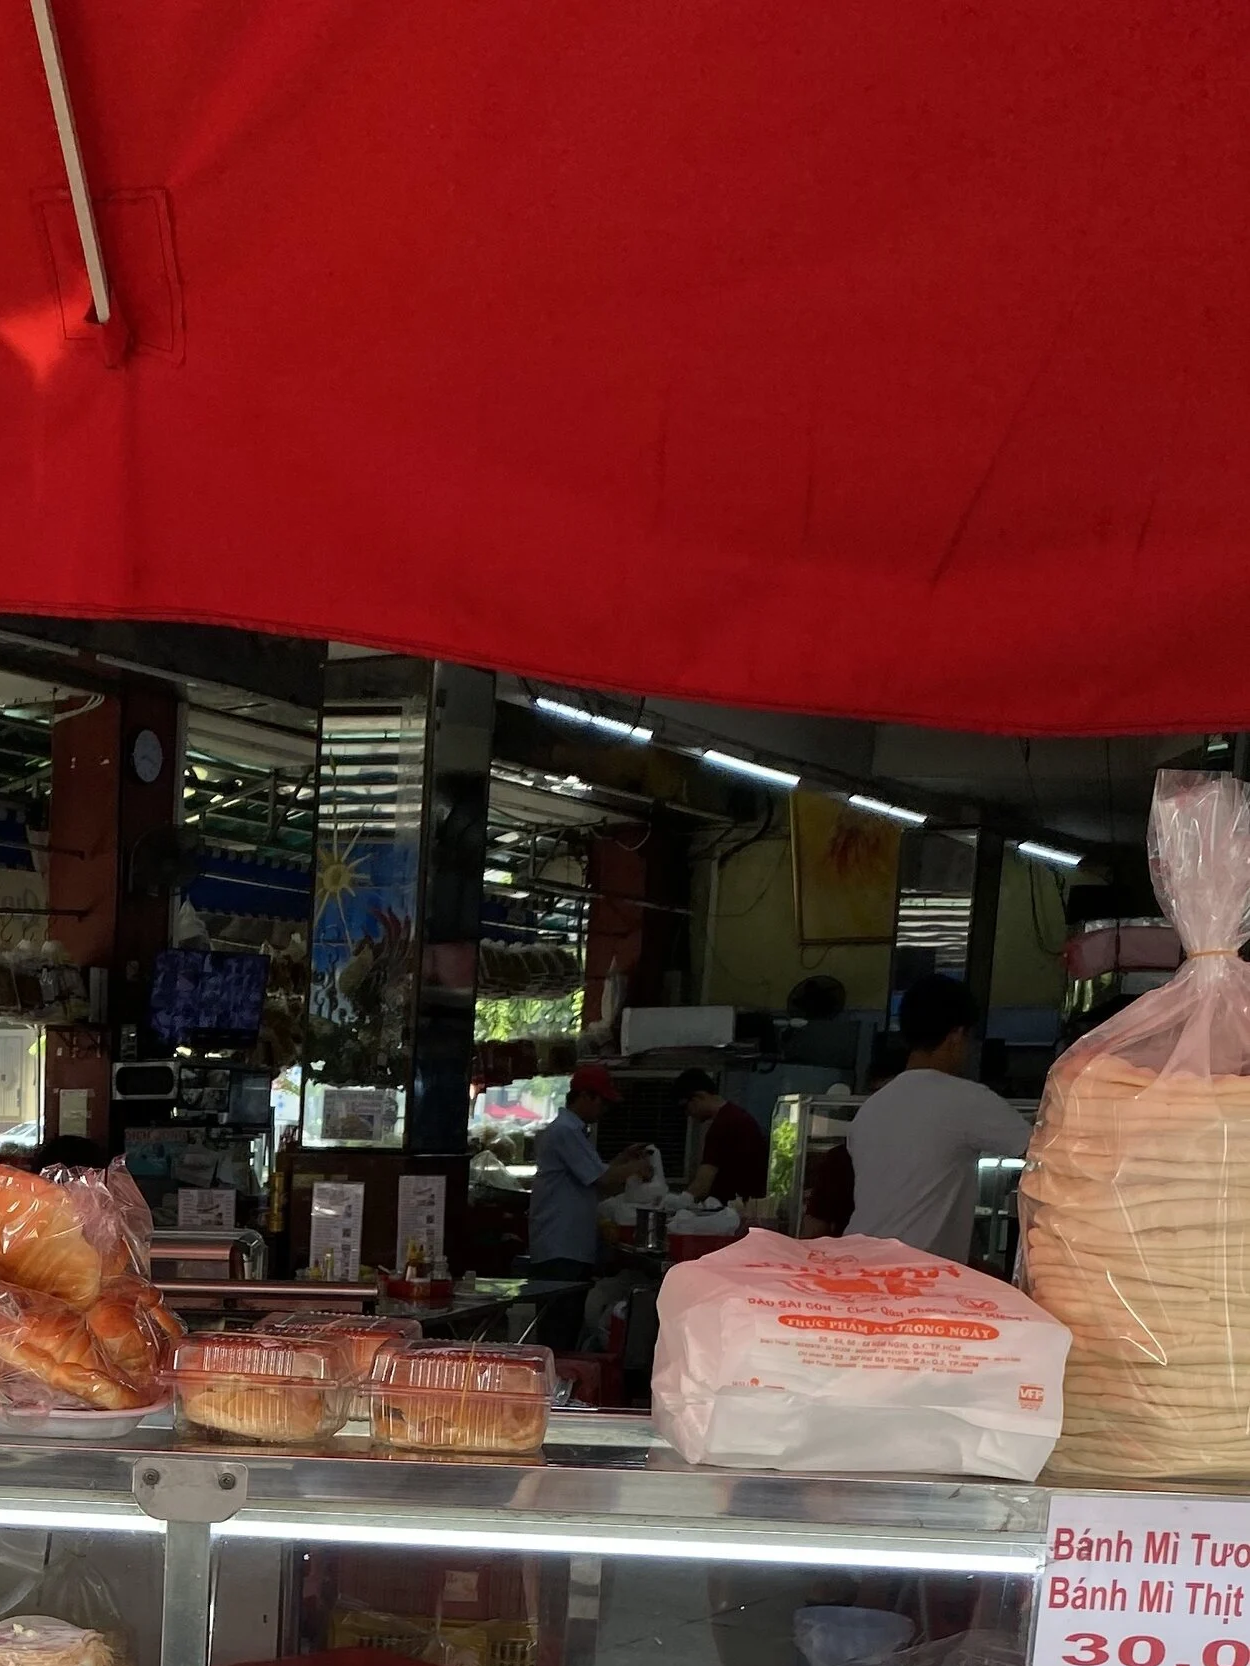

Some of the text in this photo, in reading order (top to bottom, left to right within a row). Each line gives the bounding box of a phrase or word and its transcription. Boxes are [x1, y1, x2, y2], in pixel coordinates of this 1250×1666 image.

[897, 1323, 945, 1335] TRONG
[1020, 1389, 1044, 1400] VFP
[1053, 1528, 1132, 1563] Bánh
[1144, 1531, 1180, 1564] Mì
[1048, 1577, 1244, 1624] Bánh Mì Thịt
